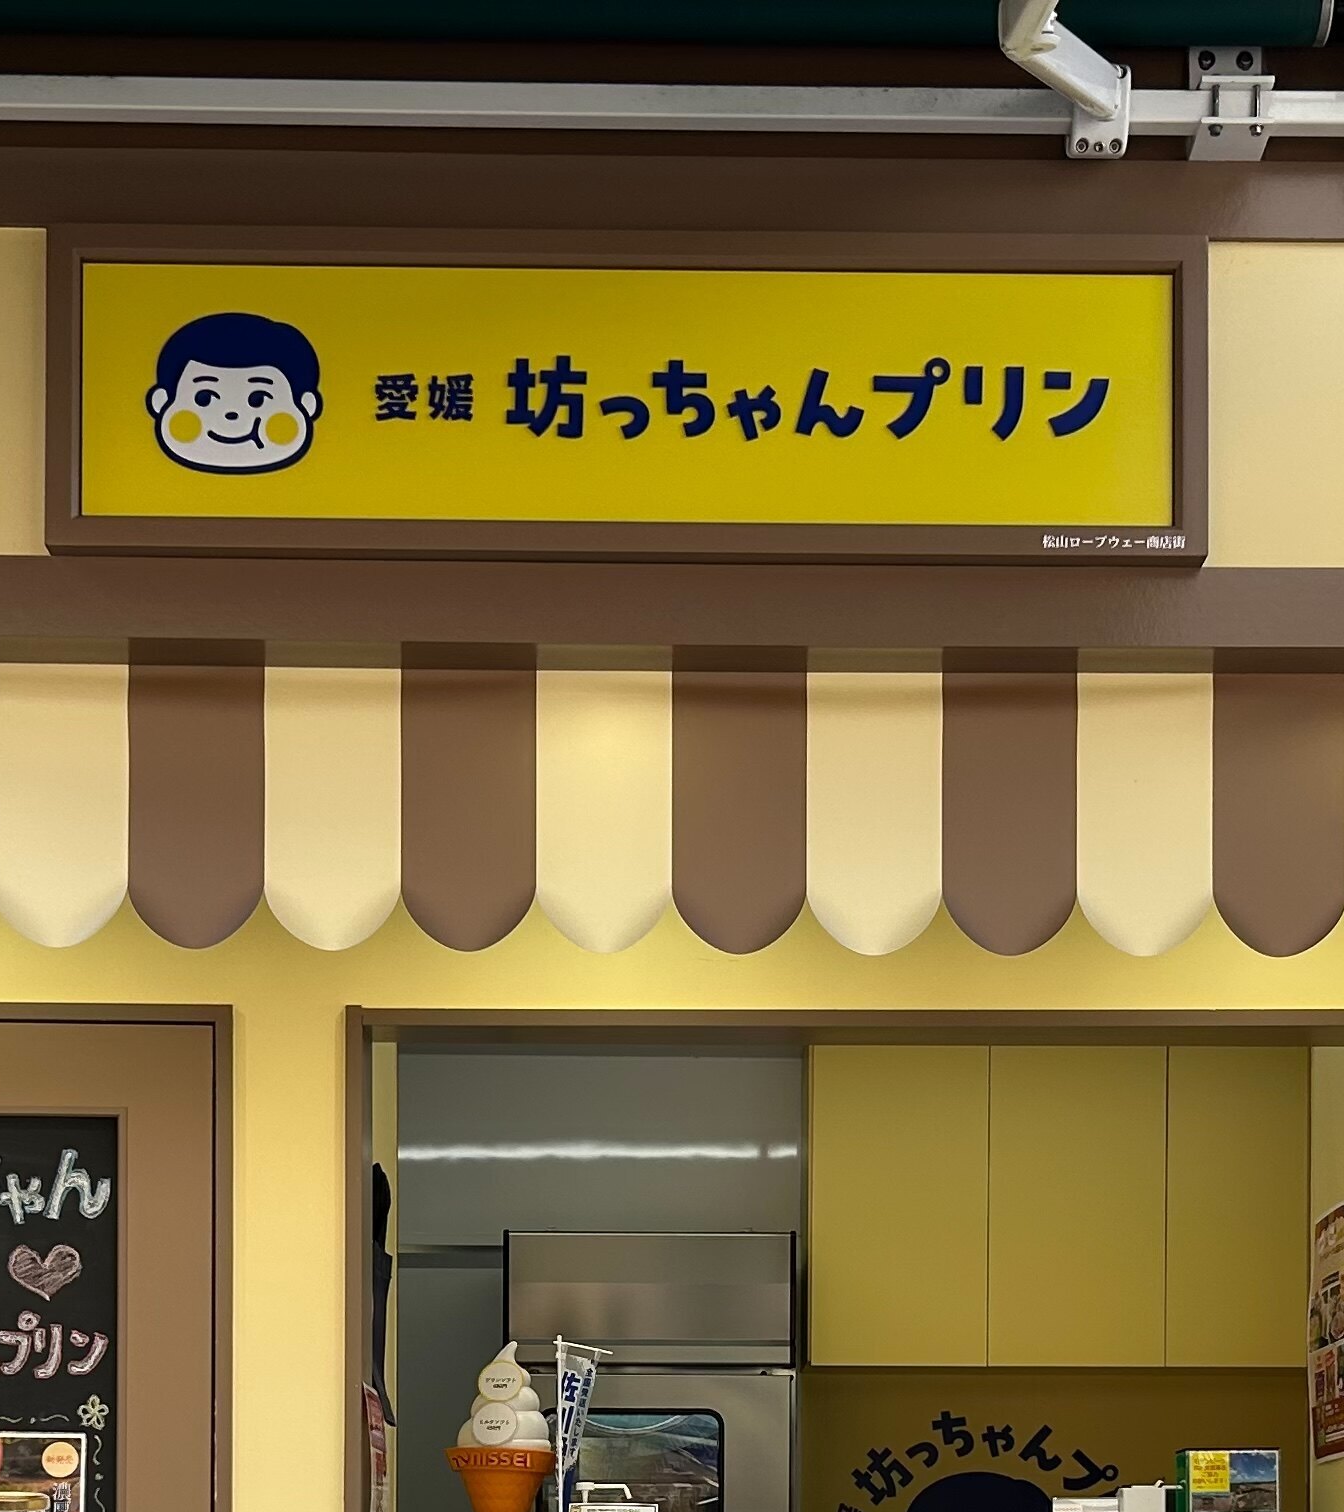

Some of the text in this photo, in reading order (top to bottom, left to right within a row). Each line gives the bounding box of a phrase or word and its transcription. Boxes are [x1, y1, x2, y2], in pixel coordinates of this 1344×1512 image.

[373, 354, 1110, 441] 愛媛 坊っちゃんプリン
[1042, 534, 1186, 549] 松山ロープウェー商店街
[469, 1453, 532, 1468] NISSEI
